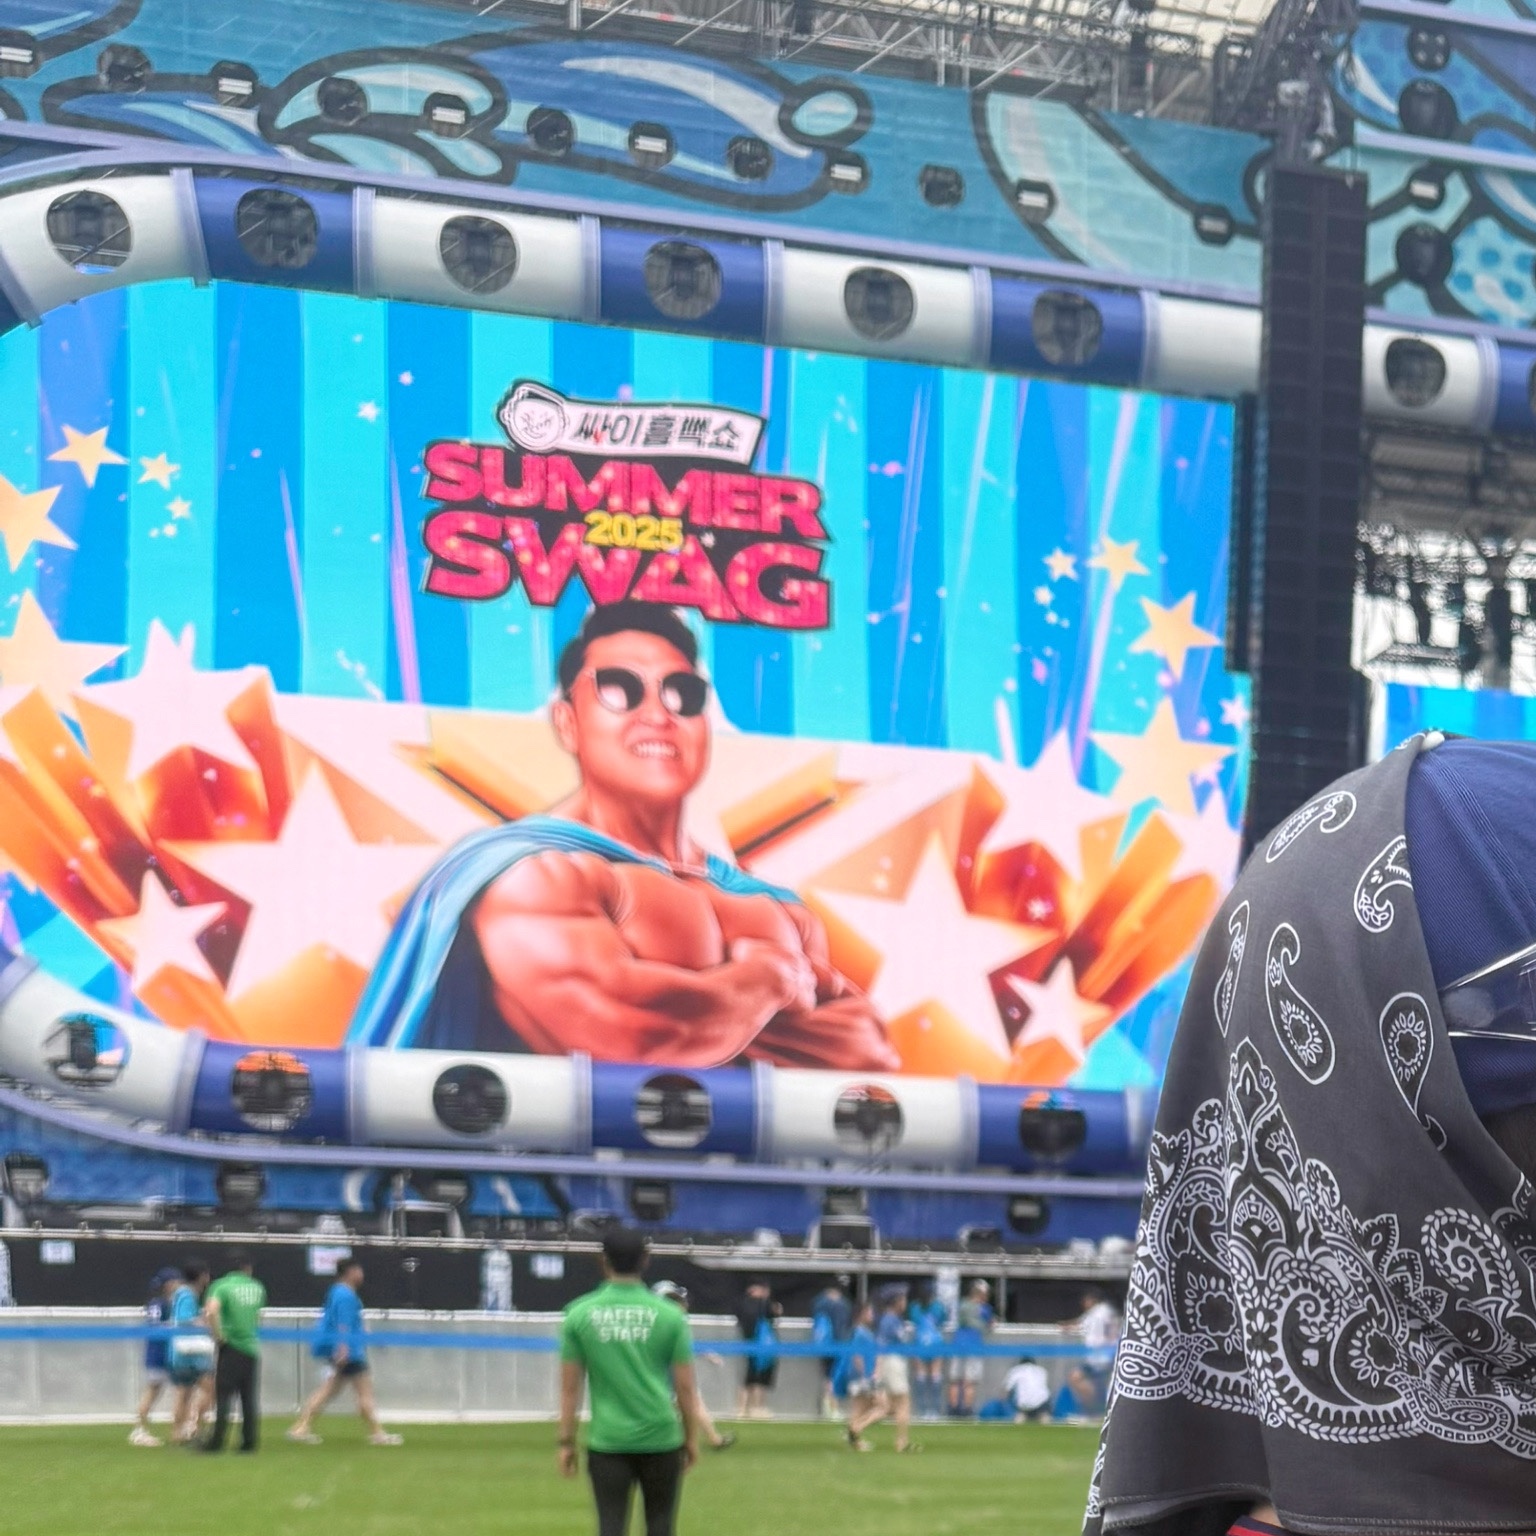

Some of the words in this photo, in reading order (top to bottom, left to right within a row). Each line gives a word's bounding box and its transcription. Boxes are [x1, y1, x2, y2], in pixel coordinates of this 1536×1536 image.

[425, 441, 830, 539] SUMMER
[584, 510, 682, 549] 2025
[425, 511, 830, 628] SWAG
[592, 1304, 658, 1326] SAFETY
[600, 1326, 649, 1343] STAFF
